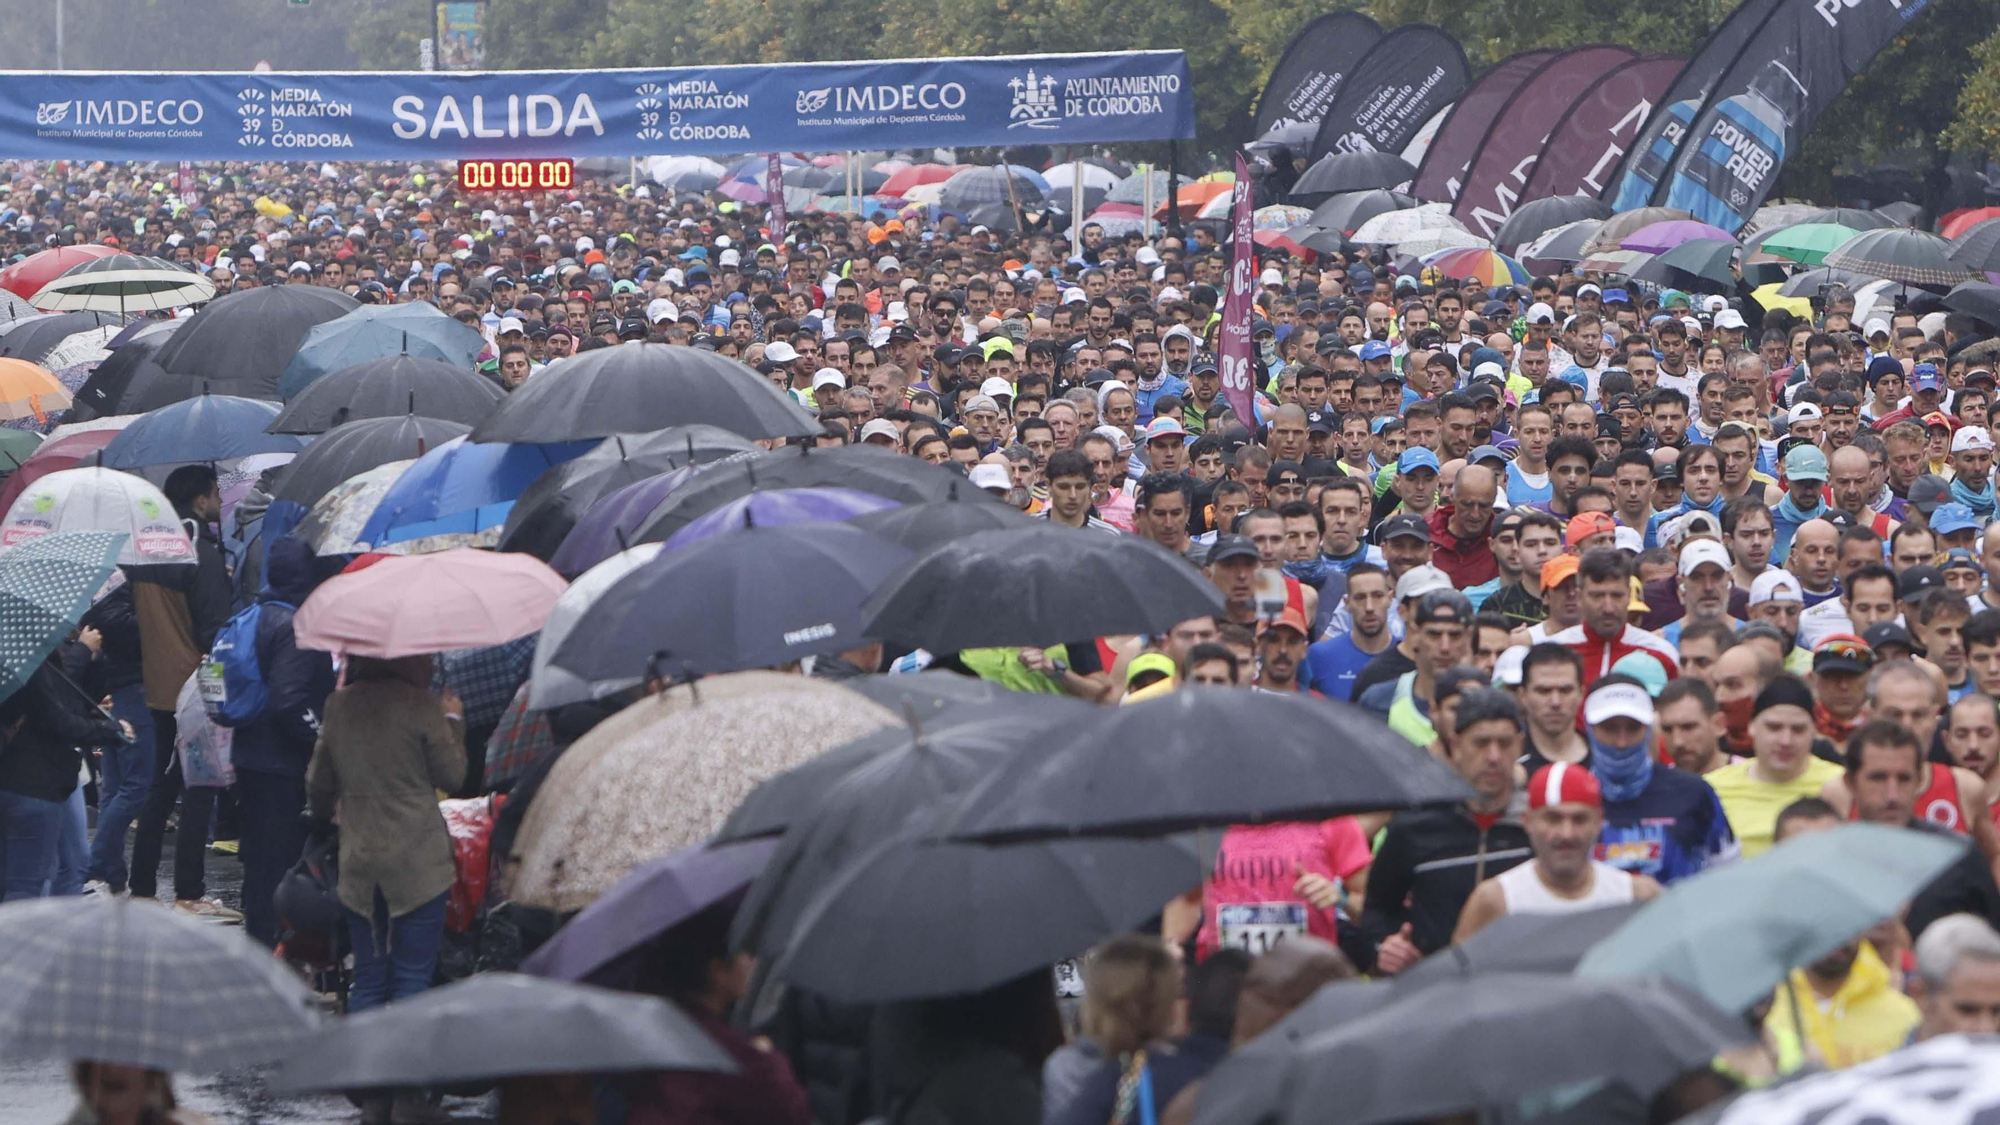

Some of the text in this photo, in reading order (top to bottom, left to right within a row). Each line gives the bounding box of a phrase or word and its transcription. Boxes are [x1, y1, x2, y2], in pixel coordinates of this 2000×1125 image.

[271, 89, 322, 102] MEDIA
[668, 80, 719, 95] MEDIA
[835, 82, 966, 112] IMDECO
[1064, 75, 1181, 97] AYUNTAMIENTO
[1288, 71, 1327, 112] Ciudades
[1298, 72, 1343, 121] Patrimonio
[271, 101, 352, 117] MARATÓN
[668, 91, 749, 110] MARATÓN
[1065, 95, 1163, 117] DE CÓRDOBA
[1355, 85, 1396, 127] Ciudades
[1364, 84, 1413, 135] Patrimonio
[1375, 65, 1446, 143] de la Humanidad
[75, 99, 204, 125] IMDECO
[392, 92, 605, 139] SALIDA
[640, 112, 660, 126] 39
[797, 112, 966, 126] Instituto Municipal de Deportes Córdoba
[37, 129, 203, 139] Instituto Municipal de Deportes Córdoba
[242, 118, 262, 132] 39
[668, 122, 751, 140] CÓRDOBA
[271, 131, 353, 147] CÓRDOBA
[1710, 119, 1774, 175] POWER
[463, 161, 571, 188] 00 00 00
[1725, 156, 1765, 191] ADE
